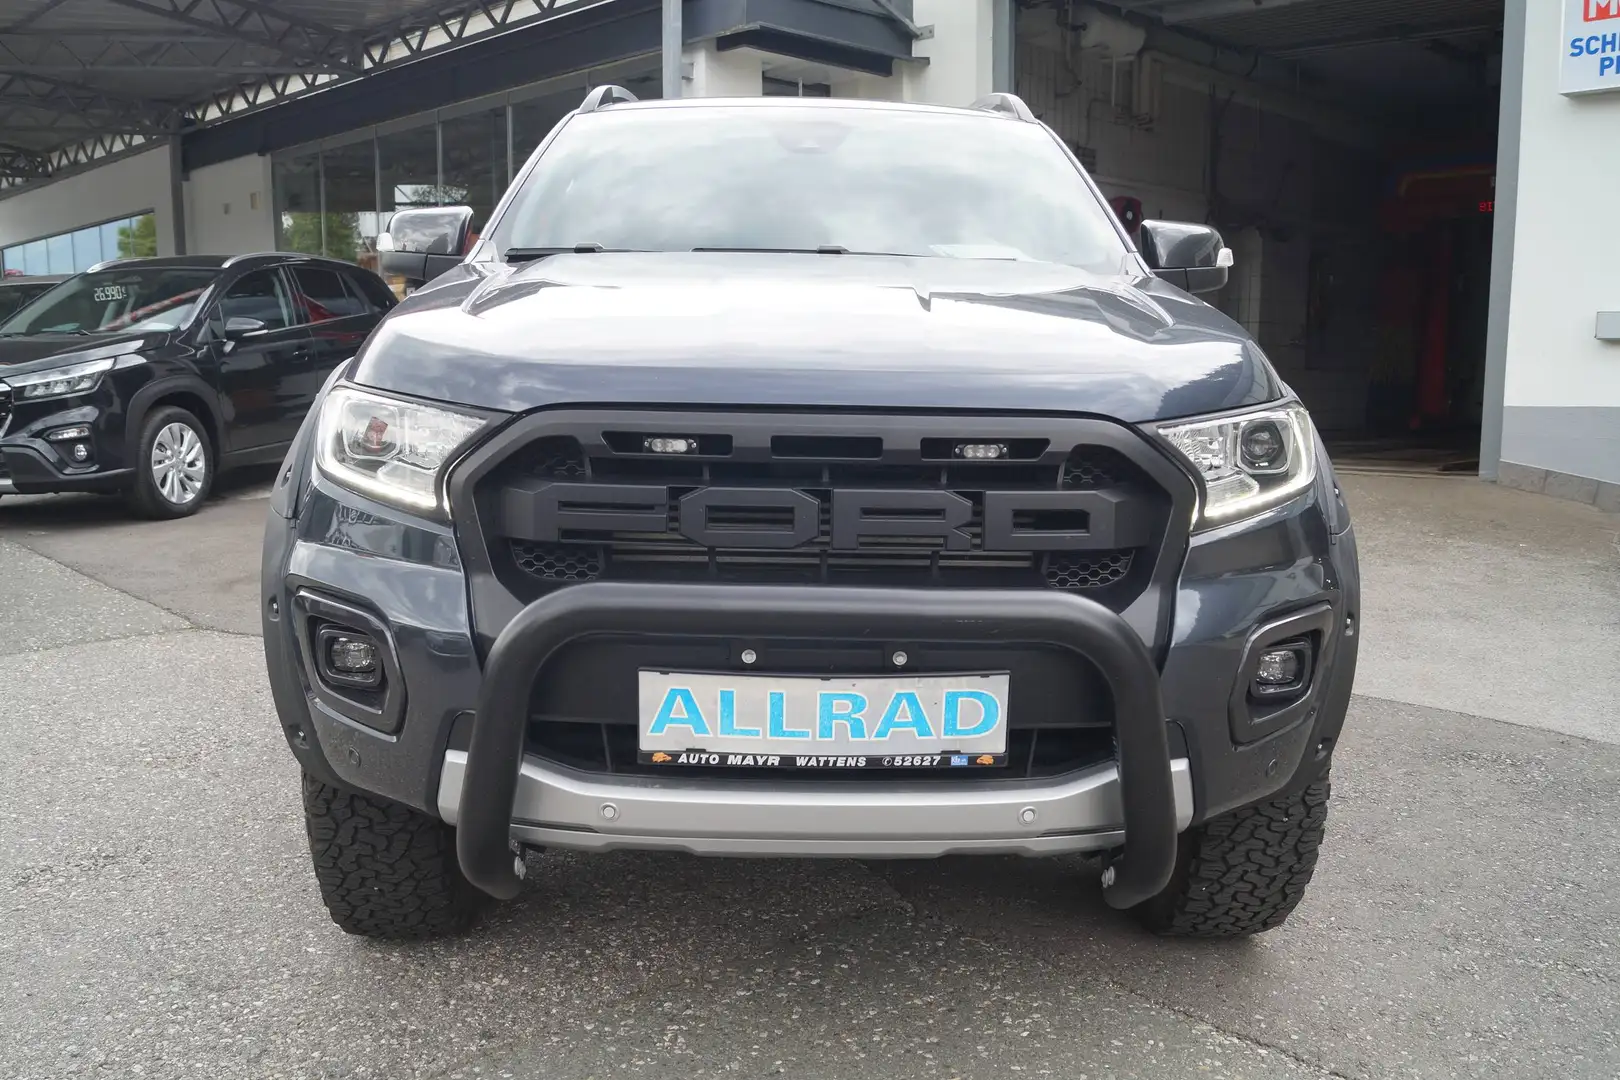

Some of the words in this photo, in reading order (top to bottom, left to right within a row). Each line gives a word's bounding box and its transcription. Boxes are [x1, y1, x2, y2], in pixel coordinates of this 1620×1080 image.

[1588, 0, 1620, 18] M
[1570, 33, 1620, 57] SCH
[507, 483, 1136, 551] FORD
[647, 687, 1001, 741] ALLRAD
[677, 753, 719, 765] AUTO
[727, 754, 780, 767] MAYR
[796, 756, 867, 767] WATTENS
[894, 755, 942, 766] 52627
